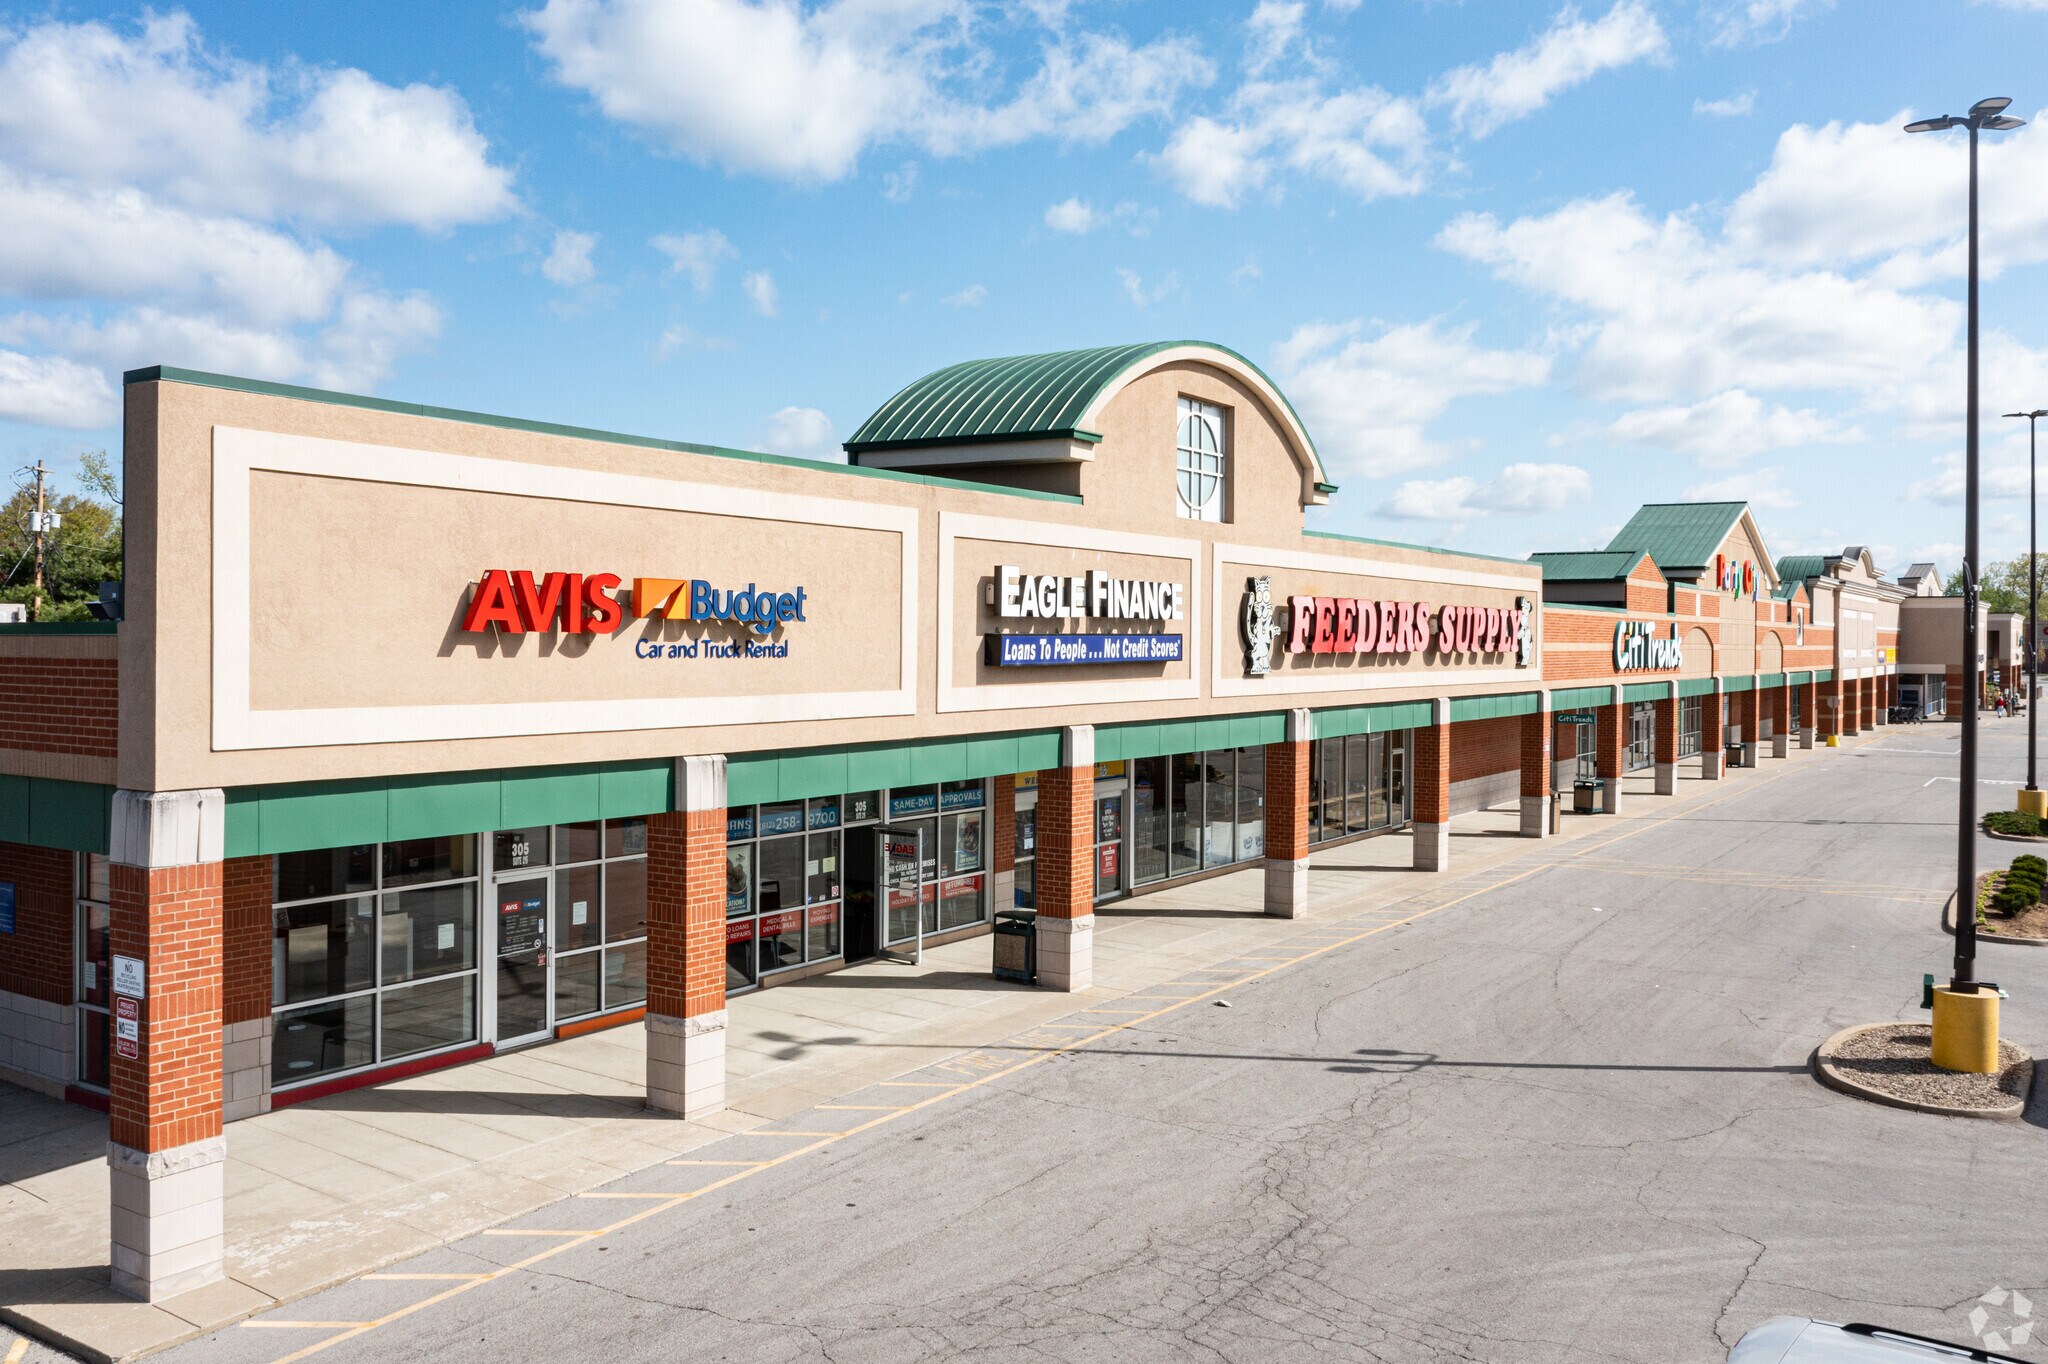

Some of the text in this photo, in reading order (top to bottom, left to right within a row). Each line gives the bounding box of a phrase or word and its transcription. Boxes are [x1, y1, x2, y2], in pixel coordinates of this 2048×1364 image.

[998, 565, 1184, 620] EAGLE FINANCE
[462, 569, 806, 634] AVIS Budget
[1288, 595, 1523, 654] FEEDERS SUPPLY
[635, 638, 788, 659] Car and Truck Rental
[1004, 638, 1037, 661] Loans
[1040, 638, 1051, 660] To
[1123, 637, 1149, 659] Credit
[894, 791, 982, 810] SAME-DAY APPROVALS
[855, 801, 867, 812] 305
[512, 843, 529, 857] 305
[506, 904, 518, 912] AVIS
[814, 908, 831, 916] MOVING
[767, 916, 787, 924] MEDICAL
[811, 914, 833, 923] EXPENSES
[733, 924, 750, 932] LOANS
[764, 924, 782, 933] DENTAL
[731, 931, 752, 939] REPAIRS
[125, 964, 134, 974] NO
